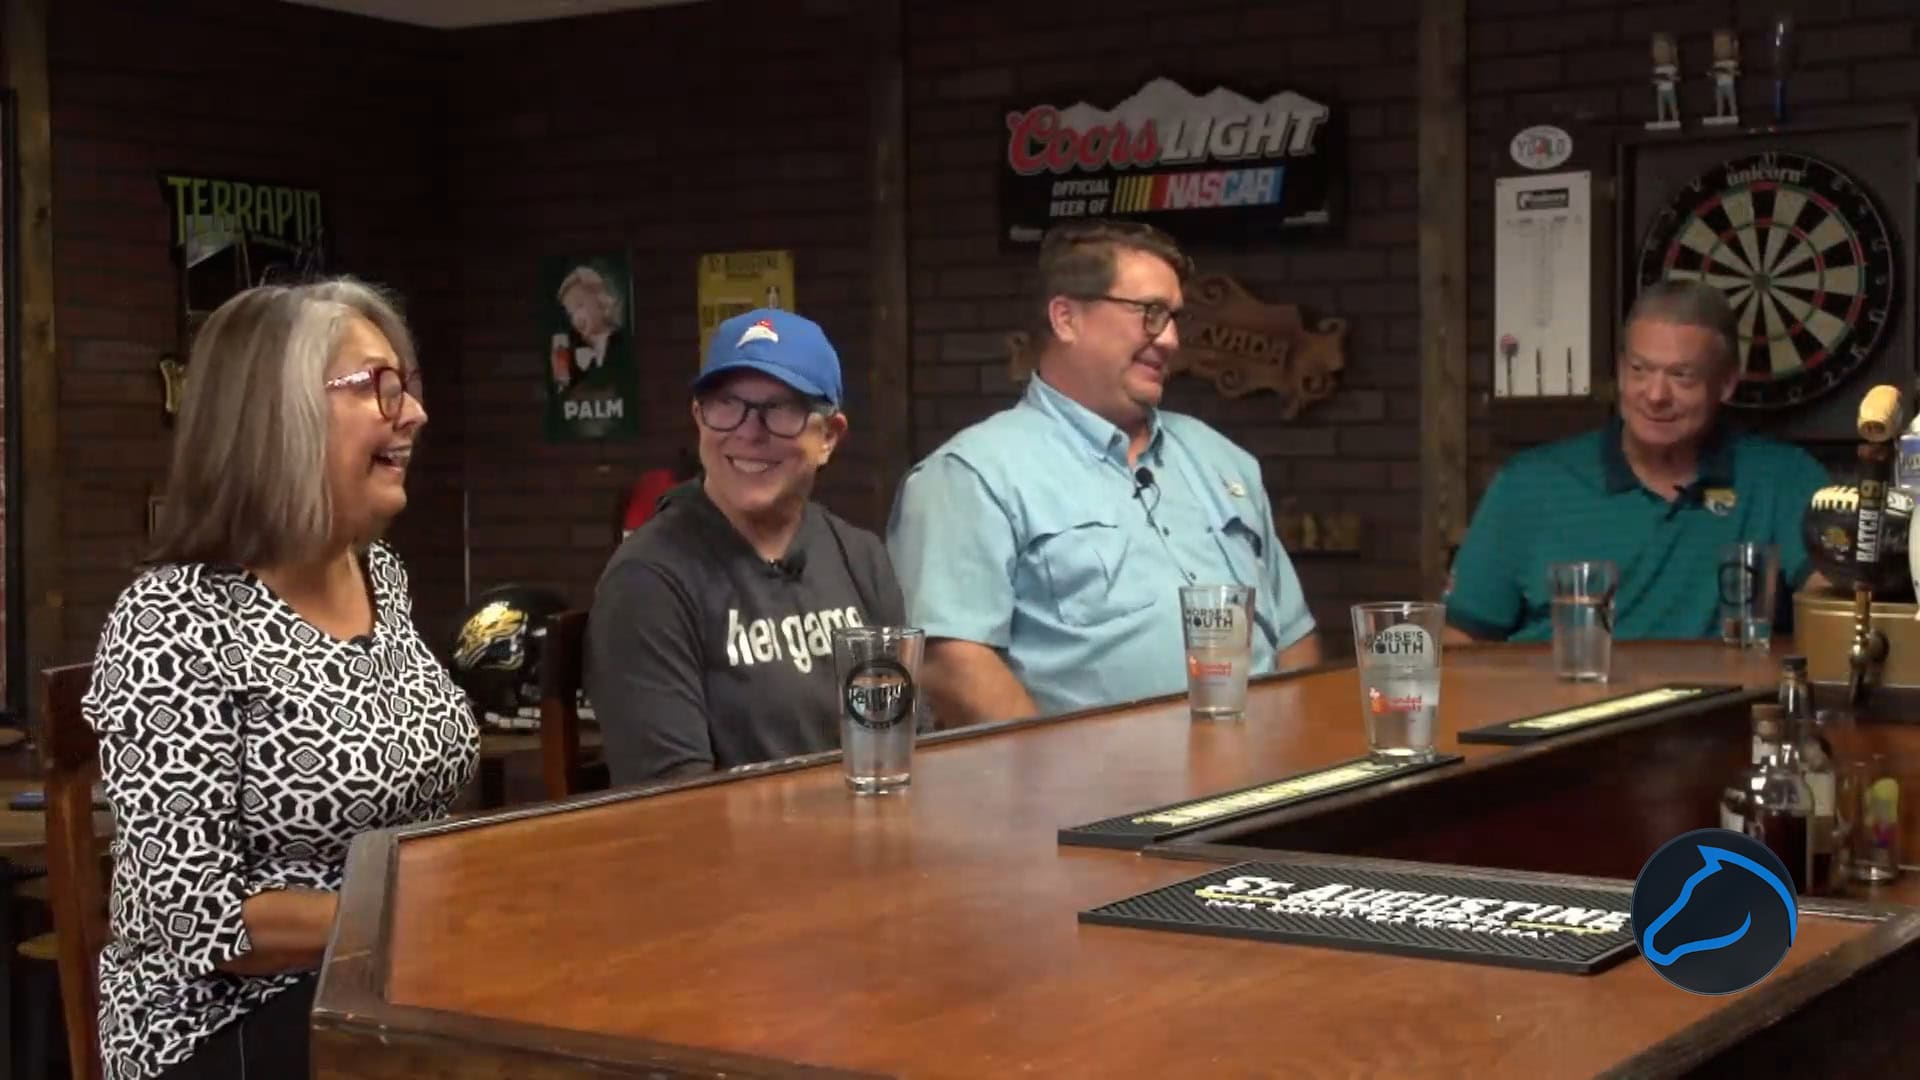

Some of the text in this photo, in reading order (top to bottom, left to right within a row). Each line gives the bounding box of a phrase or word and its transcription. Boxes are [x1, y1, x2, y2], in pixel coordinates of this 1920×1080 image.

[1006, 105, 1329, 174] Coors LIGHT
[1051, 178, 1111, 199] OFFICIAL
[1163, 167, 1274, 210] NASCAR
[1726, 163, 1801, 187] unicorn
[167, 175, 322, 248] TERRAPIN
[1049, 199, 1109, 218] BEER OF
[563, 397, 625, 420] PALM
[1855, 509, 1880, 562] BATCH
[1283, 883, 1632, 932] AUGUSTINE
